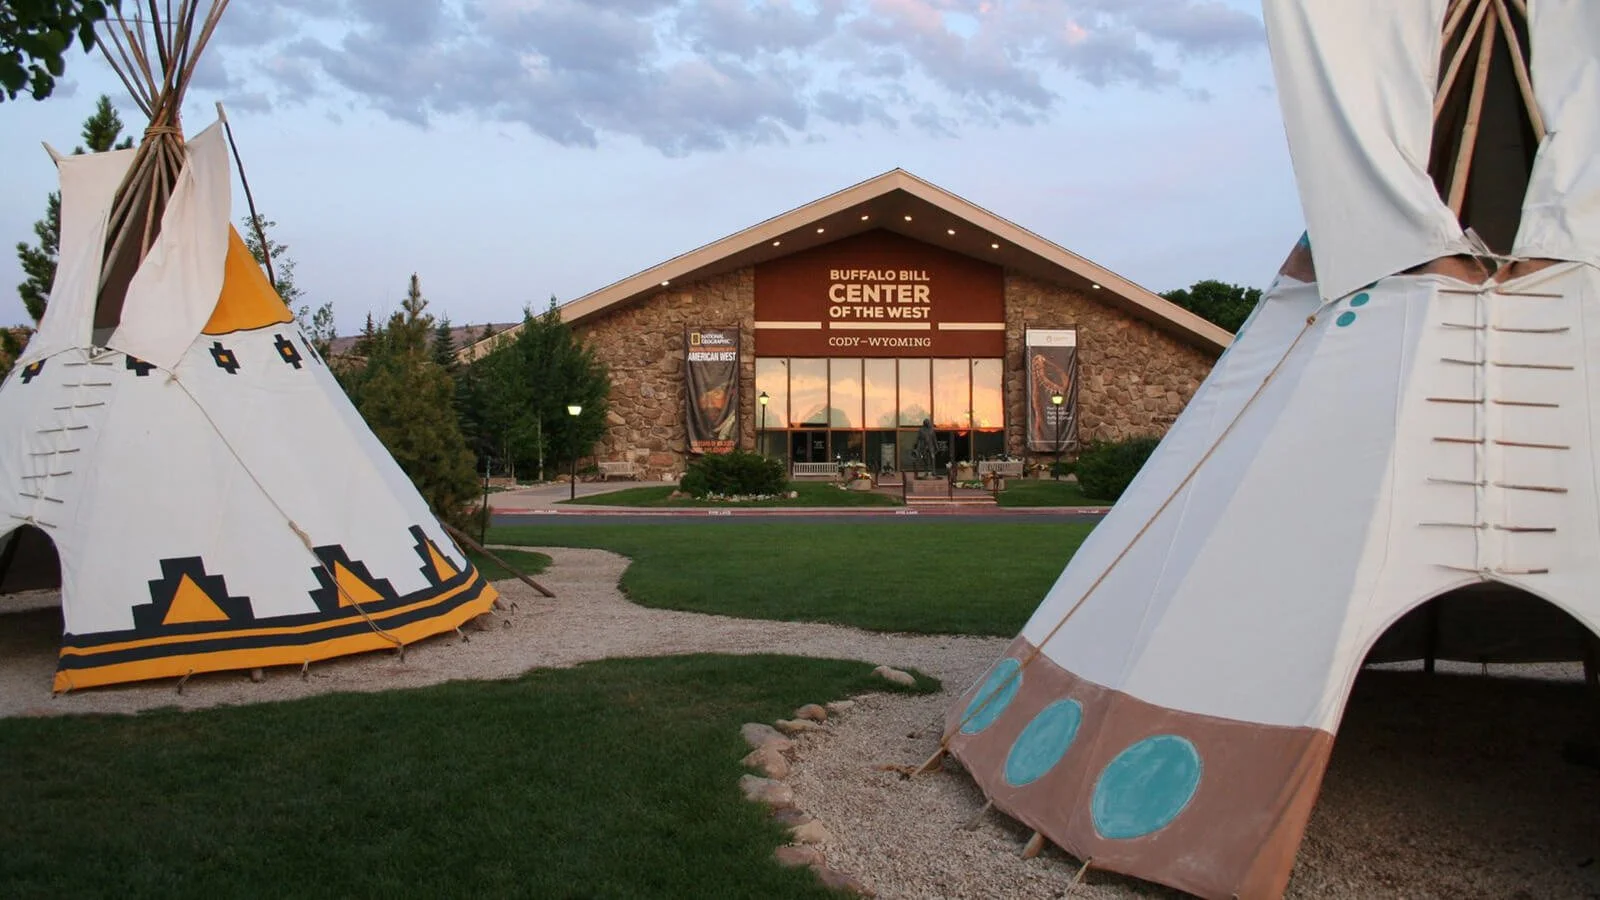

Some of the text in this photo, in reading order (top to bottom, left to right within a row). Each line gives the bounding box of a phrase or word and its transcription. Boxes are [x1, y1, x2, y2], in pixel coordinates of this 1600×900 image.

[830, 269, 930, 281] BUFFALO BILL
[829, 283, 931, 303] CENTER
[829, 306, 931, 318] OF THE WEST
[688, 351, 736, 361] AMERICAN WEST
